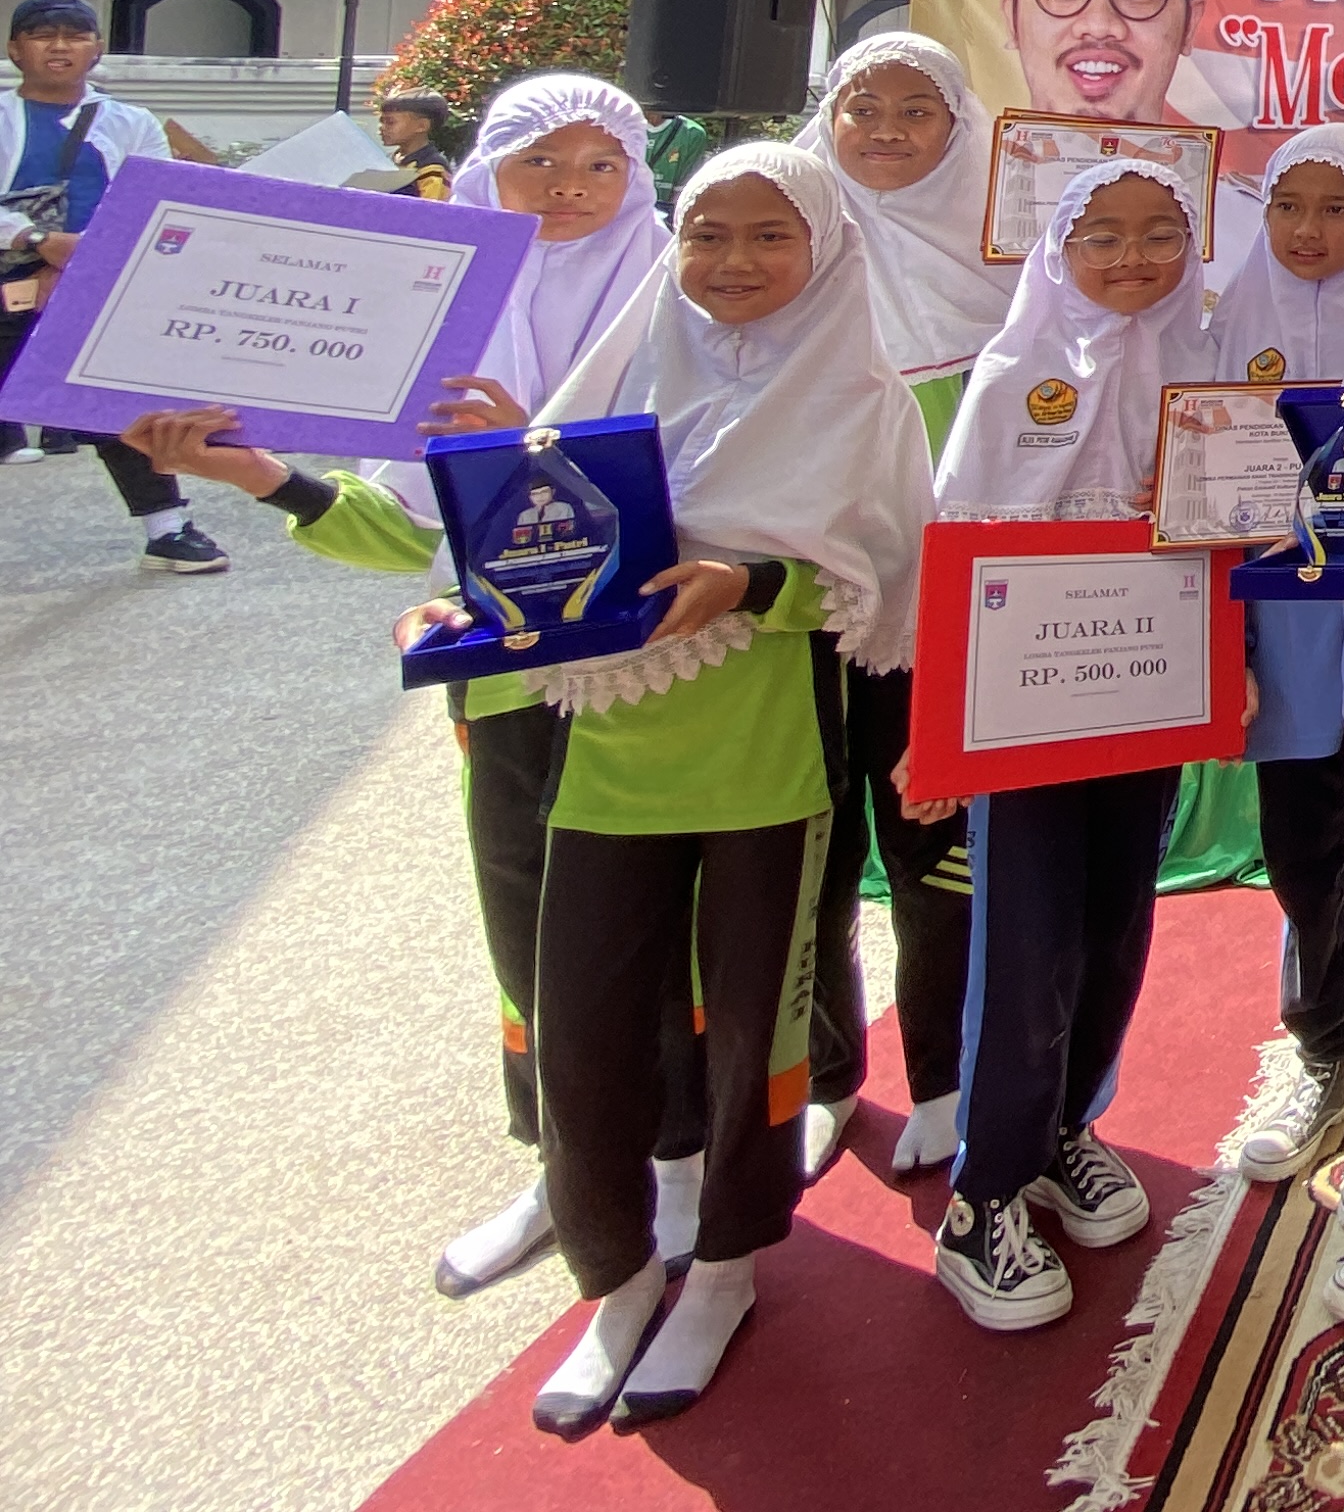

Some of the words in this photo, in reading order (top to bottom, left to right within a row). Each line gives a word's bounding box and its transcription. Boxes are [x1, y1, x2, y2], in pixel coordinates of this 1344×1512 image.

[259, 253, 347, 274] SELAMAT
[210, 280, 333, 312] JUARA
[342, 297, 361, 314] I
[162, 319, 222, 344] RP.
[236, 329, 297, 354] 750.
[309, 339, 365, 361] 000
[1244, 465, 1275, 473] JUARA
[1065, 588, 1129, 599] SELAMAT
[1035, 619, 1126, 640] JUARA
[1135, 616, 1155, 633] II
[1019, 667, 1066, 687] RP.
[1074, 662, 1121, 682] 500.
[1129, 658, 1168, 677] 000
